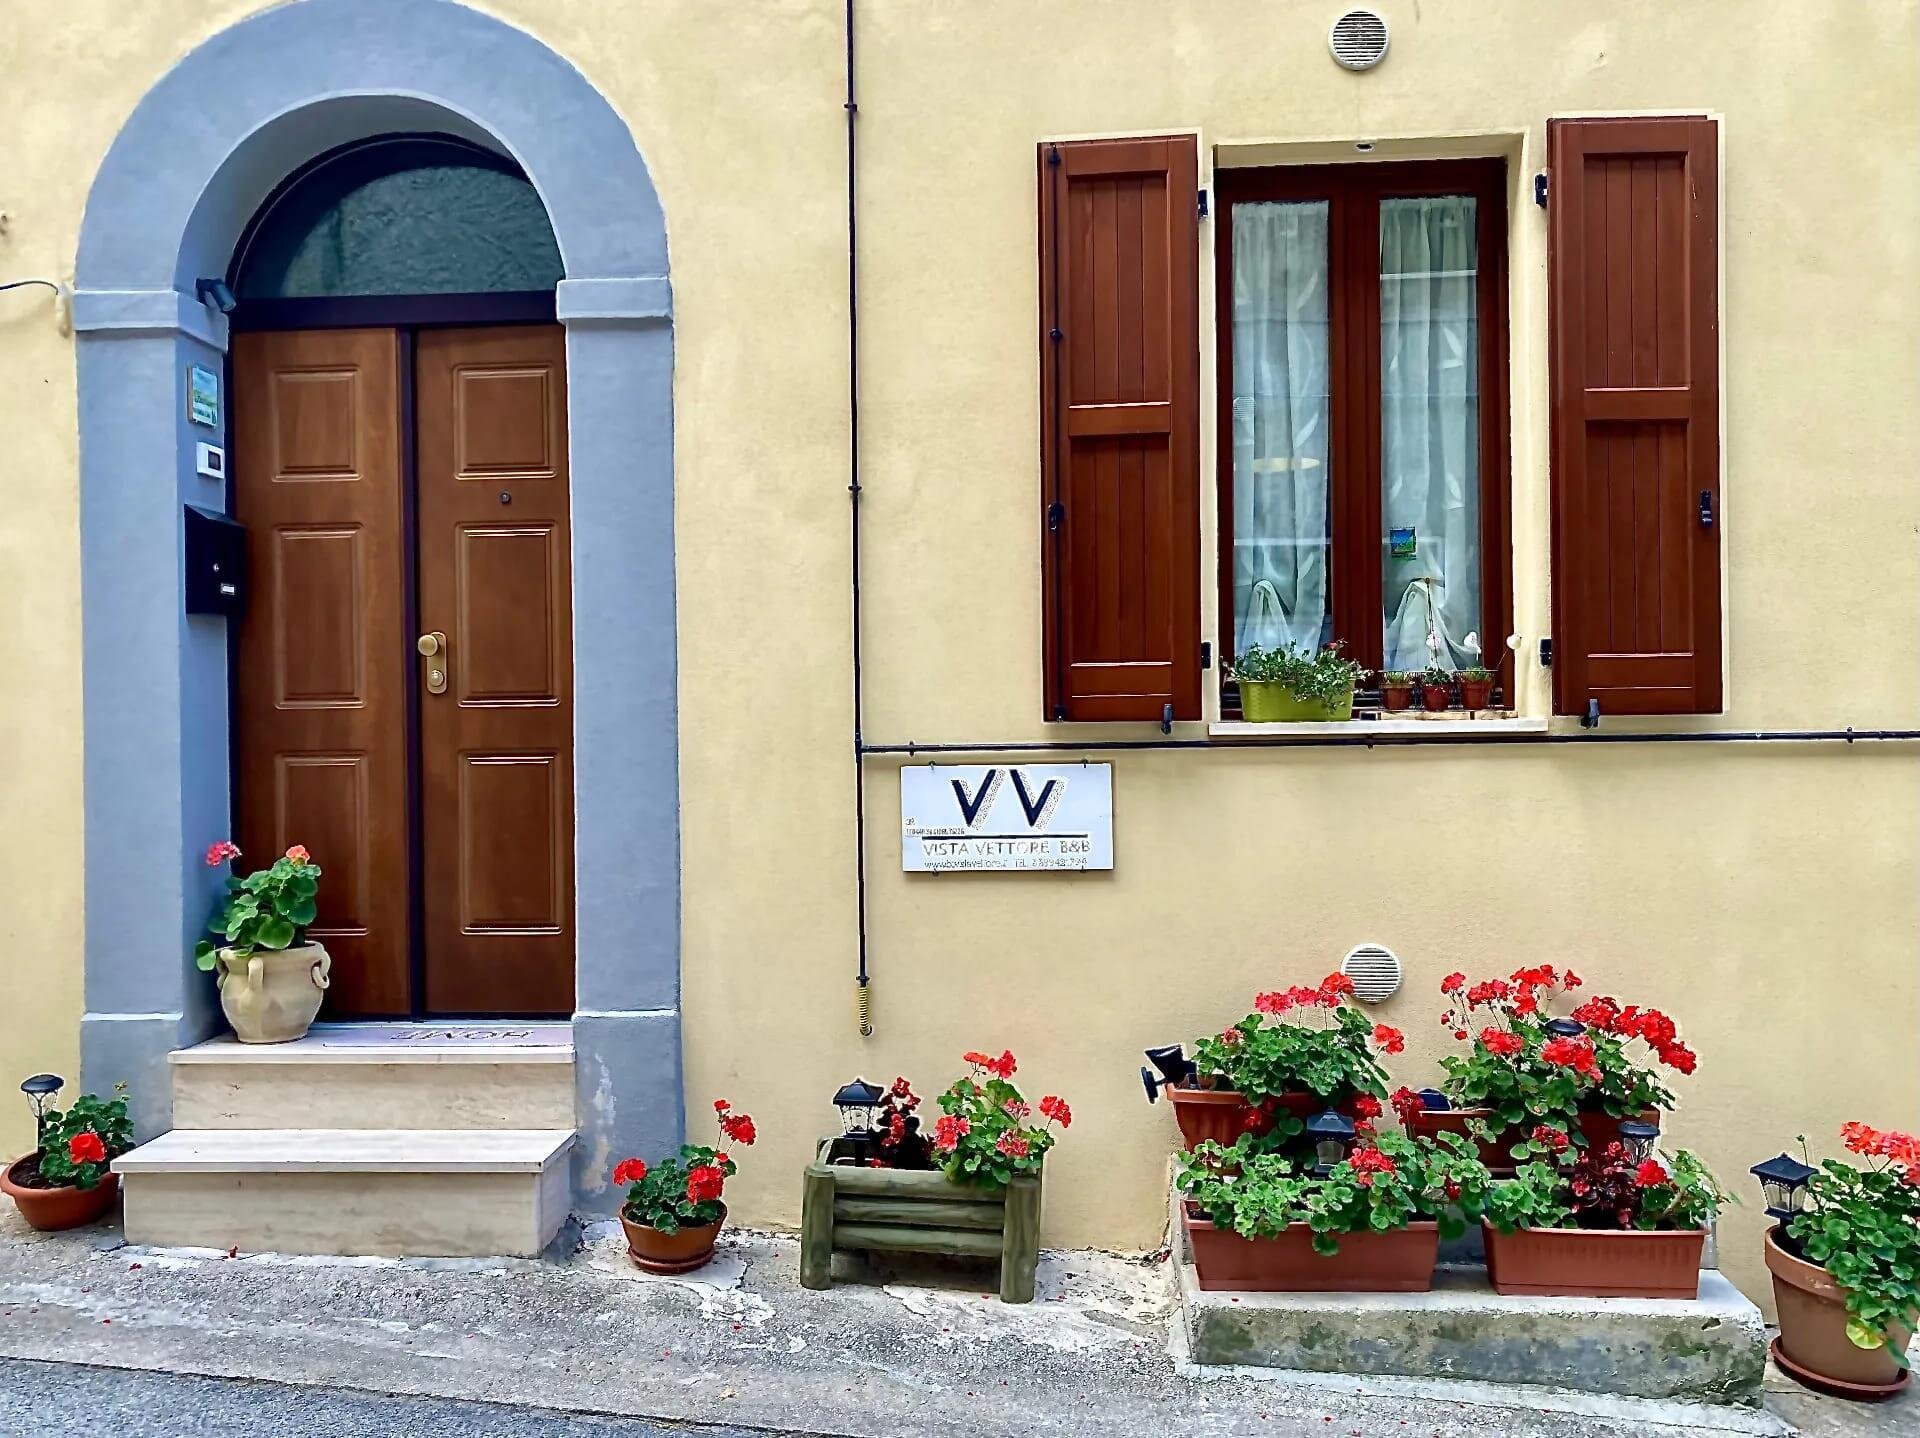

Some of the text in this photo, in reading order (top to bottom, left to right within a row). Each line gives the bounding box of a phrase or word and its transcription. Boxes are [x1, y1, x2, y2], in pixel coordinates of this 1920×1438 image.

[923, 840, 1090, 856] VISTA VETTORE B&B
